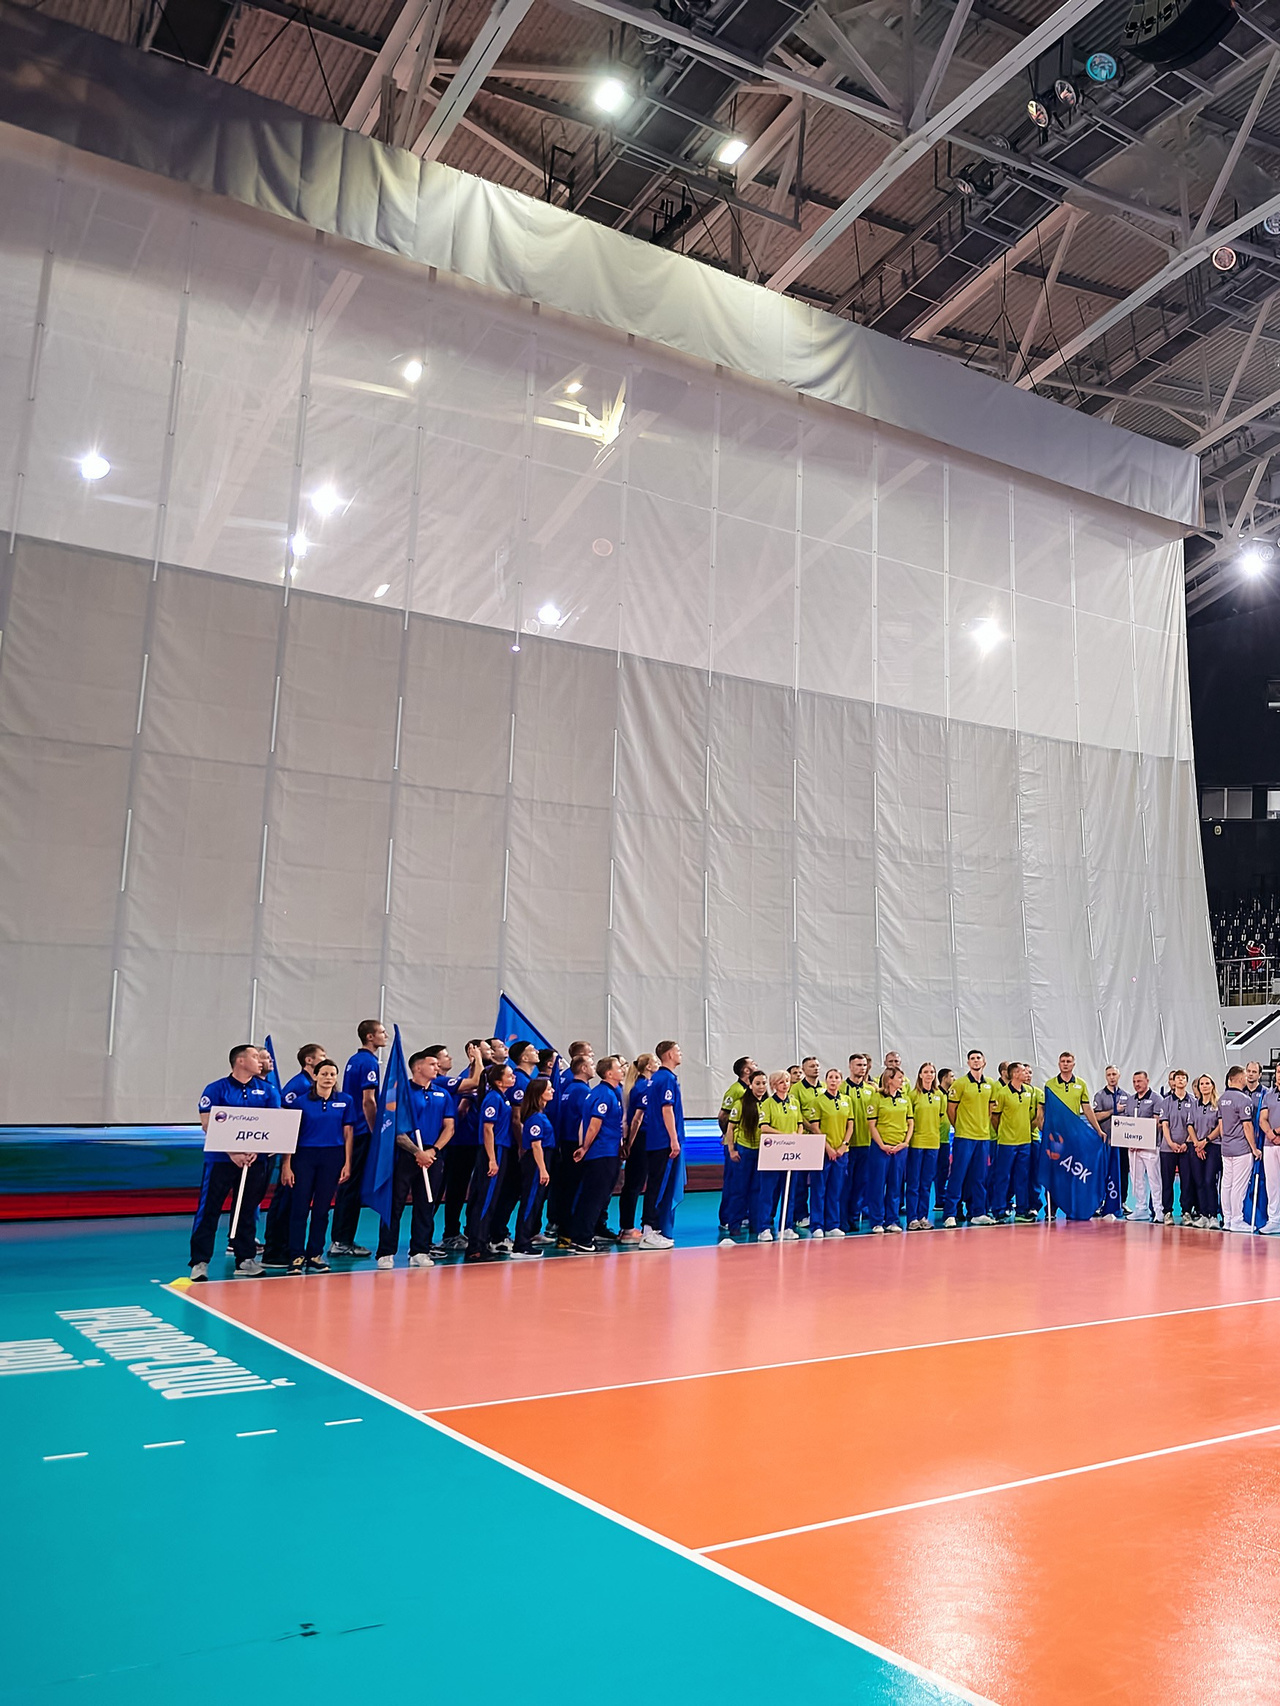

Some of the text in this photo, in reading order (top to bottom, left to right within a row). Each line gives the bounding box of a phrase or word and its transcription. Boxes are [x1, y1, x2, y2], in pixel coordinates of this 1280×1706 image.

[228, 1113, 260, 1122] РусГидро
[235, 1130, 270, 1141] ДРСК
[1124, 1132, 1143, 1141] Центр
[782, 1152, 801, 1161] ДЭК
[1059, 1155, 1093, 1184] ДЭК
[54, 1304, 297, 1401] КРАСНОЯРСКИЙ
